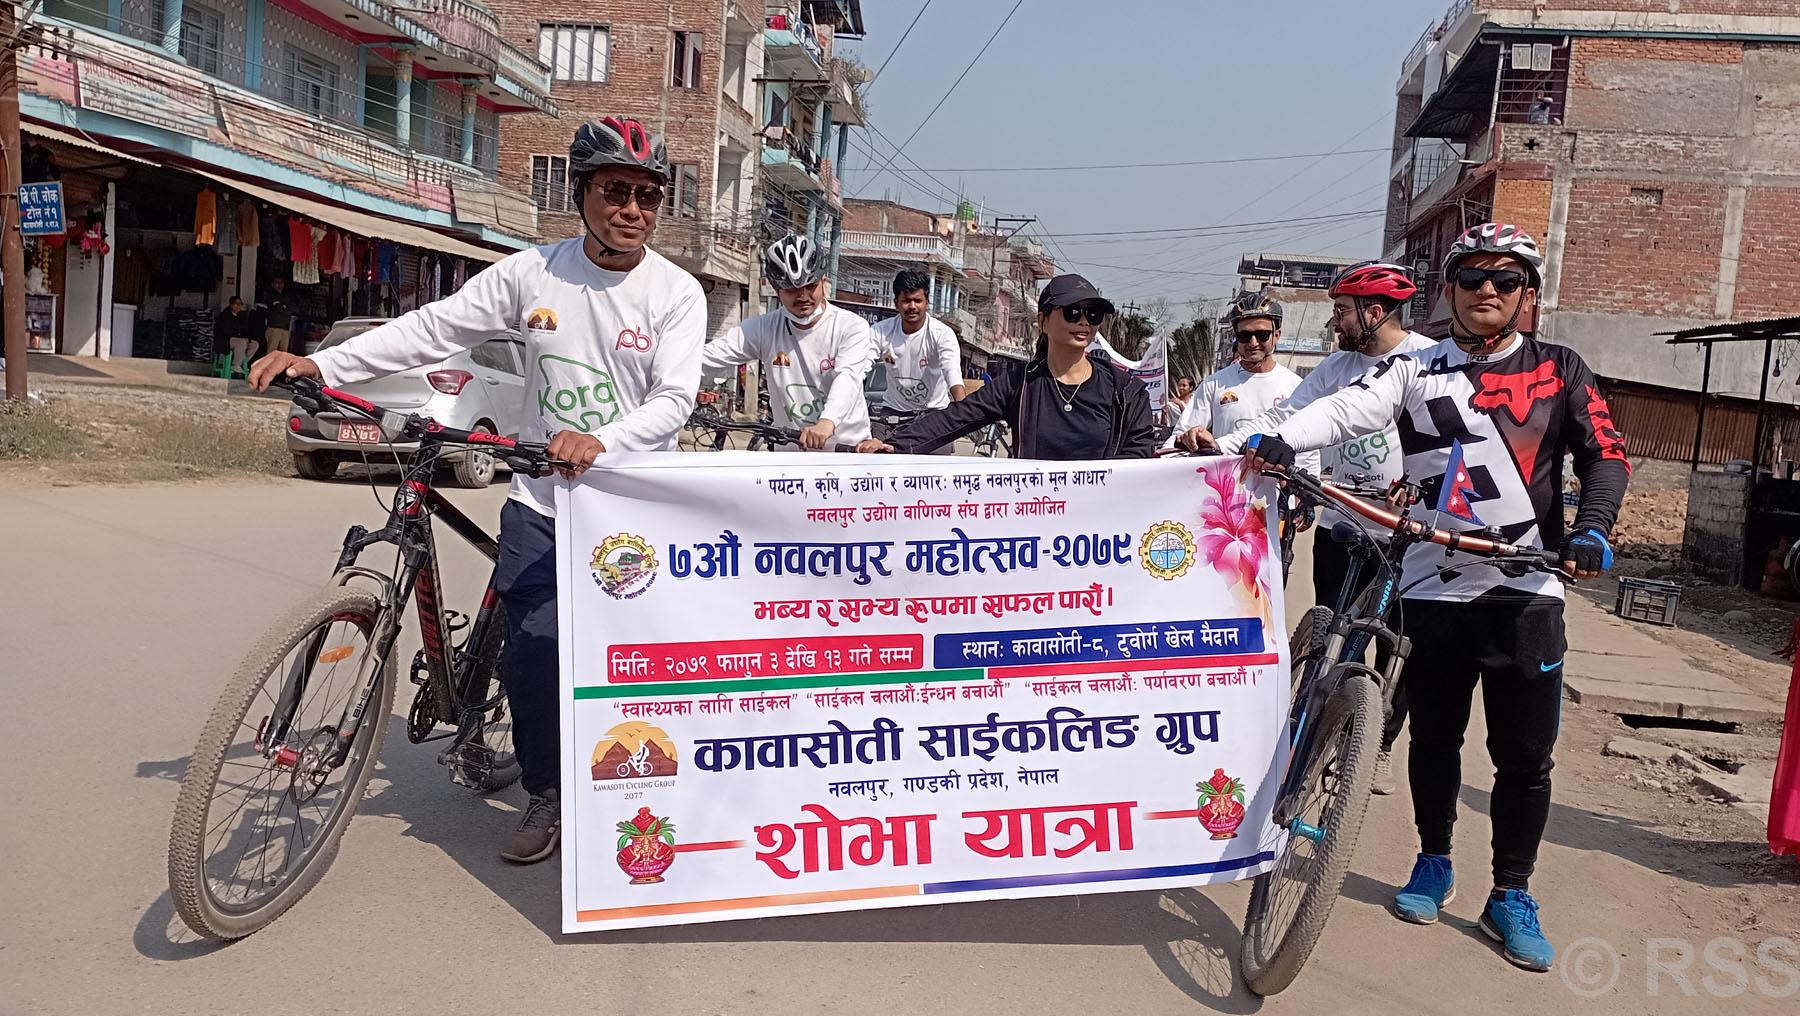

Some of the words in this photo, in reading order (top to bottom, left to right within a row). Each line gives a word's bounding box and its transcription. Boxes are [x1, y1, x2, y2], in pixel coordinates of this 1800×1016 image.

[26, 205, 41, 219] टोल
[1471, 354, 1490, 362] FOX
[538, 382, 616, 416] Kora
[785, 398, 825, 421] Kor
[1339, 432, 1388, 464] Kora
[769, 475, 808, 498] पर्यटन,
[815, 475, 843, 499] कृषि,
[850, 473, 883, 492] उद्योग
[889, 477, 898, 492] र
[953, 475, 981, 495] समृद्ध
[986, 469, 1044, 494] नवलपुरको
[1049, 472, 1067, 492] मूल
[807, 506, 856, 529] नवलपुर
[862, 502, 898, 522] उद्योग
[904, 499, 951, 520] वाणिज्य
[958, 500, 979, 519] संघ
[984, 503, 1009, 519] द्वारा
[1015, 496, 1066, 516] आयोजित
[669, 530, 742, 578] ७औं
[754, 542, 894, 585] नवलपुर
[905, 528, 1131, 576] महोत्सव-२०७९
[816, 600, 839, 627] र
[839, 598, 899, 623] सभ्य
[905, 596, 977, 623] रूपमा
[982, 592, 1054, 618] सफल
[1164, 626, 1194, 648] खेल
[1201, 622, 1239, 646] मैदान
[665, 656, 709, 676] २०७९
[716, 653, 763, 678] फागुन
[770, 653, 778, 673] ३
[785, 646, 817, 669] देखि
[824, 650, 841, 669] १३
[849, 644, 873, 665] गते
[879, 648, 913, 664] सम्म
[699, 693, 733, 714] लागि
[1143, 671, 1201, 690] पर्यावरण
[694, 717, 904, 772] कावासोती
[918, 707, 1139, 762] साईकलिङ
[1154, 711, 1221, 755] ग्रुप
[624, 792, 643, 800] 2077
[828, 779, 893, 801] नवलपुर,
[903, 769, 961, 793] गण्डकी
[967, 769, 1008, 791] प्रदेश,
[1017, 766, 1059, 785] नेपाल
[753, 803, 937, 880] शोभा
[962, 801, 1137, 858] यात्रा
